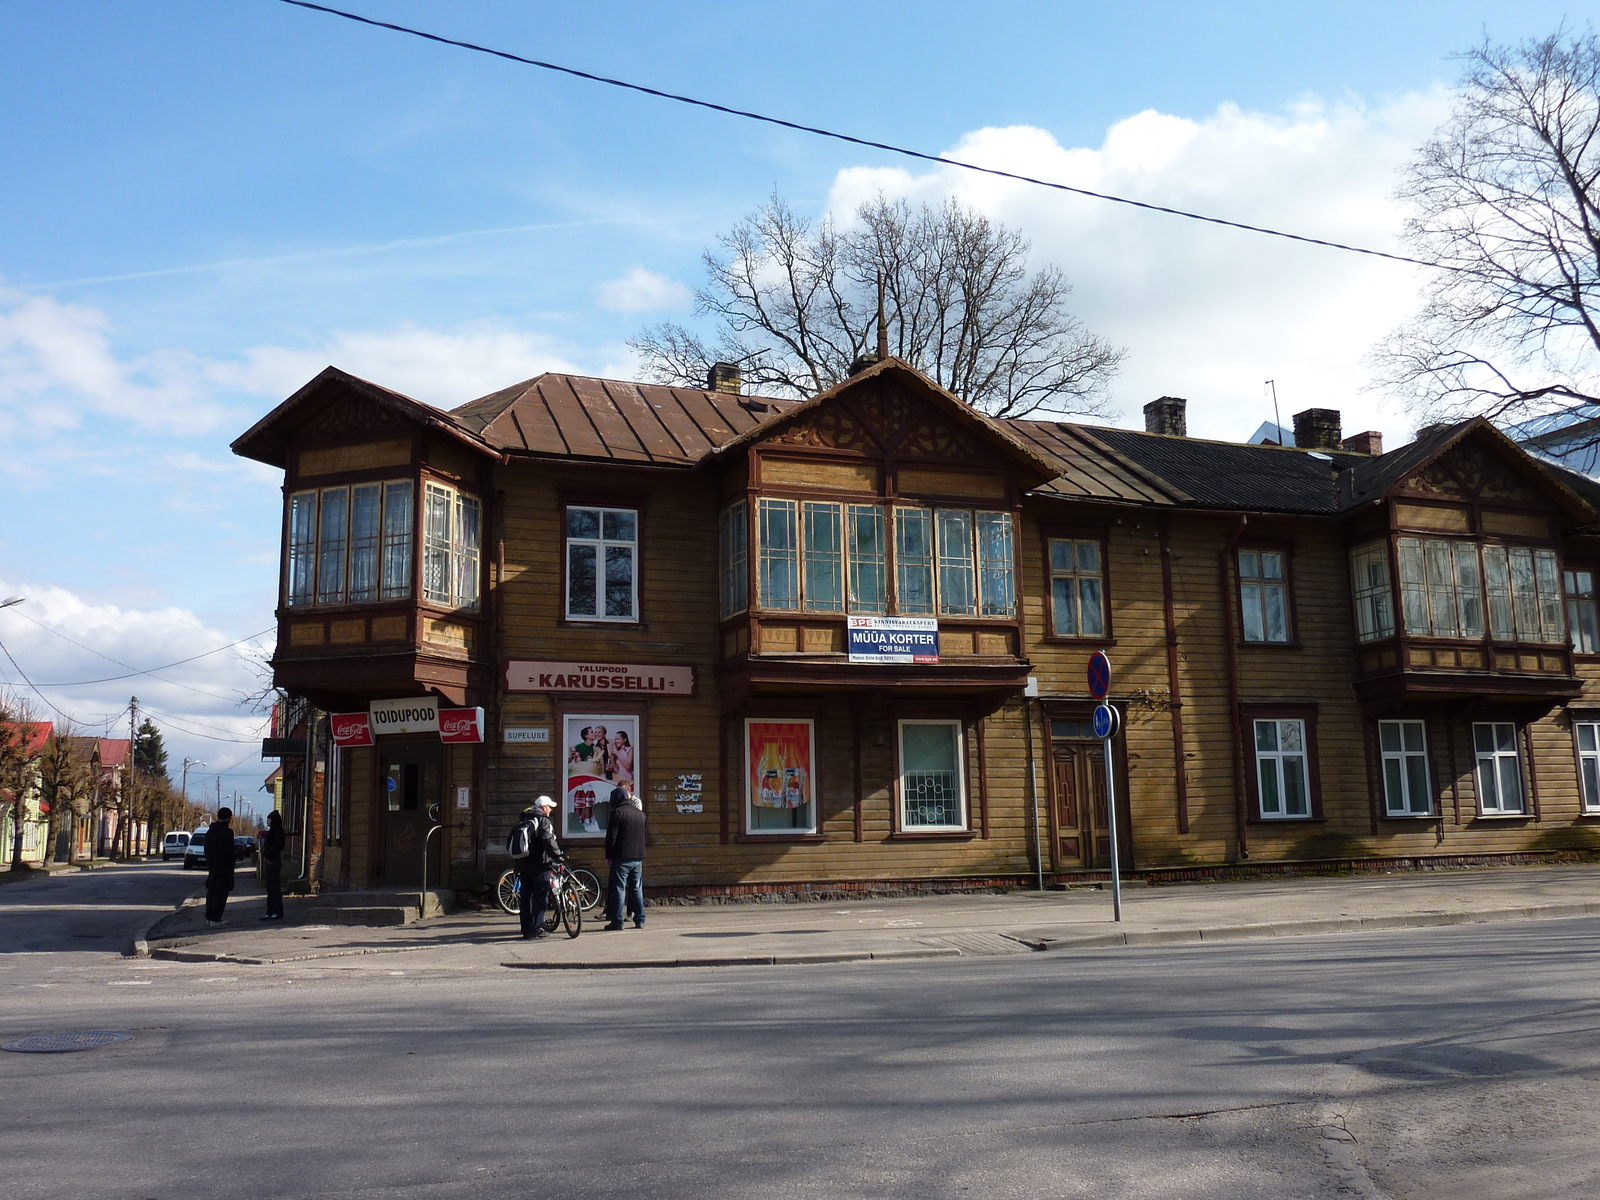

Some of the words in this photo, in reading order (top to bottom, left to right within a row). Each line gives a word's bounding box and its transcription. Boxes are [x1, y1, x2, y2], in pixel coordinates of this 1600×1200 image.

[853, 630, 887, 643] MÜÜA
[889, 633, 934, 645] KORTER
[578, 665, 628, 673] TALUPOOD
[539, 673, 665, 690] KARUSSELLI
[374, 707, 435, 724] TOIDUPOOD
[507, 731, 546, 739] SUPELUSE
